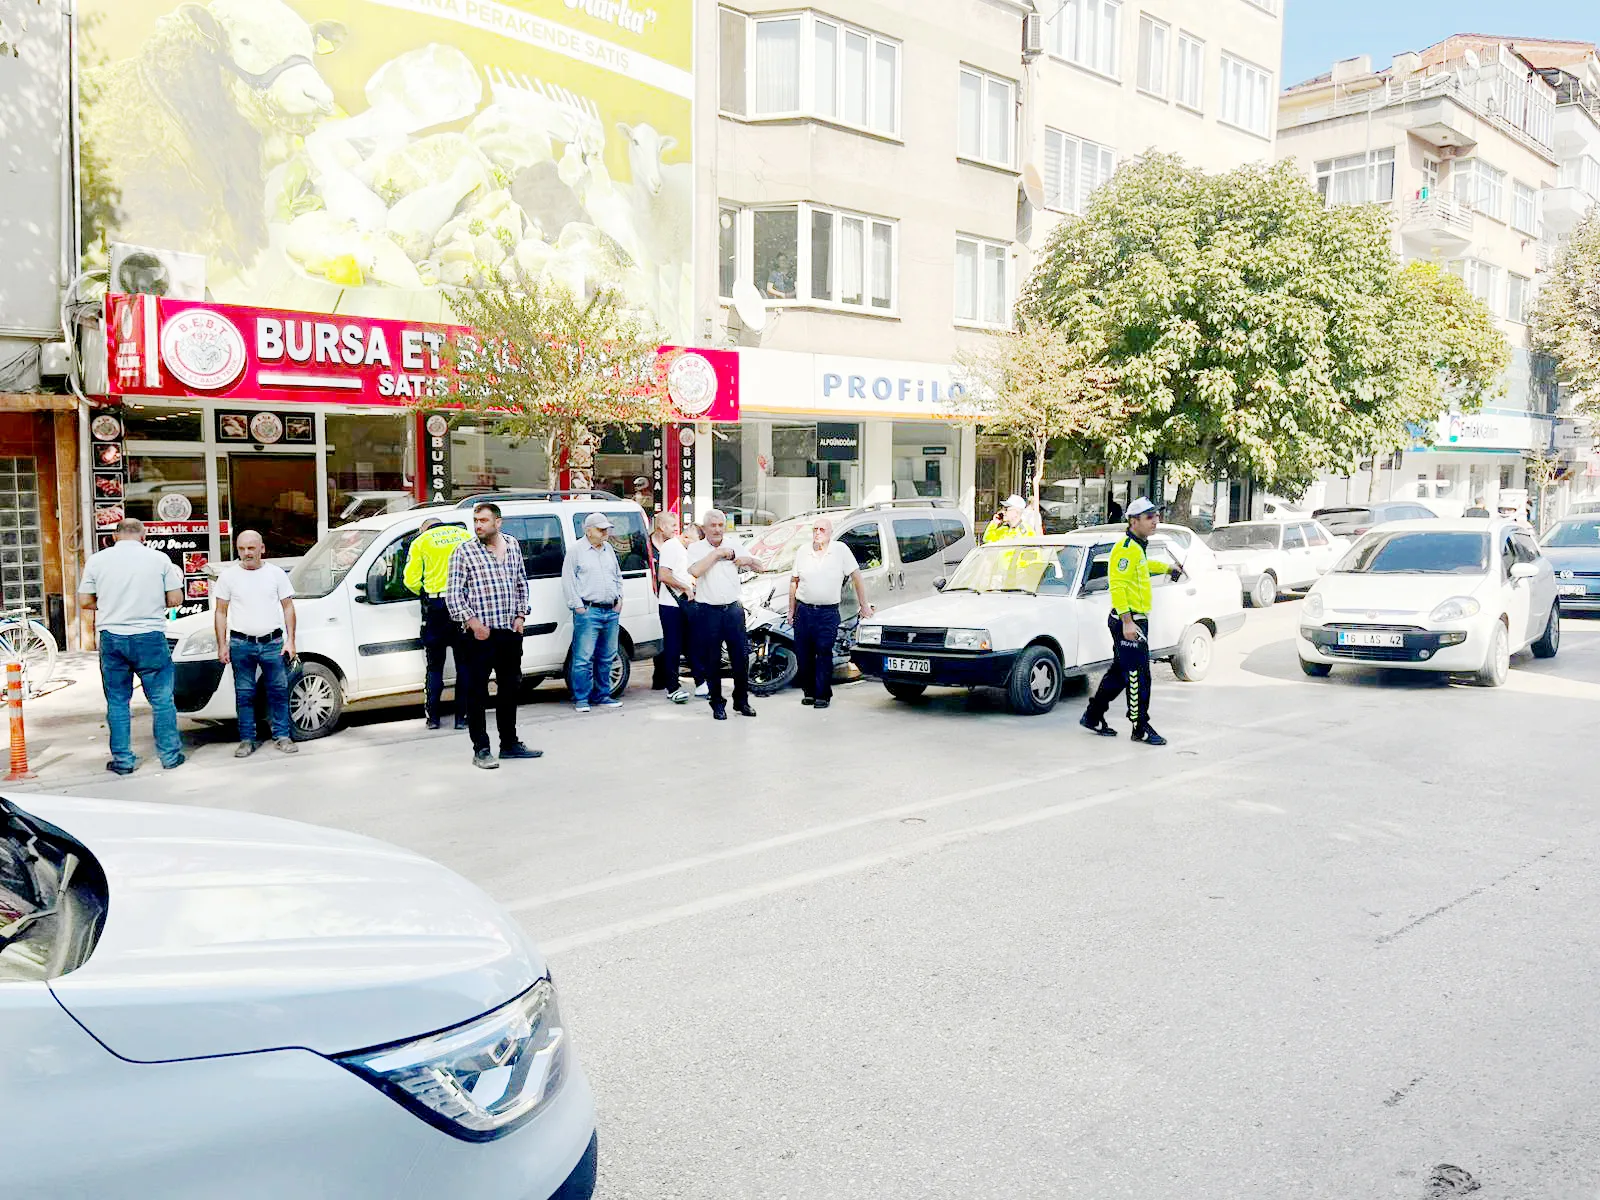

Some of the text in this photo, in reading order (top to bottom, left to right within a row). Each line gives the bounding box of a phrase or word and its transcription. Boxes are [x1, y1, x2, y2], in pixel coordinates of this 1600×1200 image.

[466, 1, 629, 69] PERAKENDE SATIŞ
[256, 317, 391, 366] BURSA
[401, 329, 446, 370] ET
[431, 436, 445, 503] BURSA
[653, 438, 661, 491] BURSA
[683, 447, 692, 505] BURSA
[167, 539, 196, 550] Dana
[888, 658, 929, 672] 16 F 2720
[1345, 634, 1402, 645] 16 LAS 42
